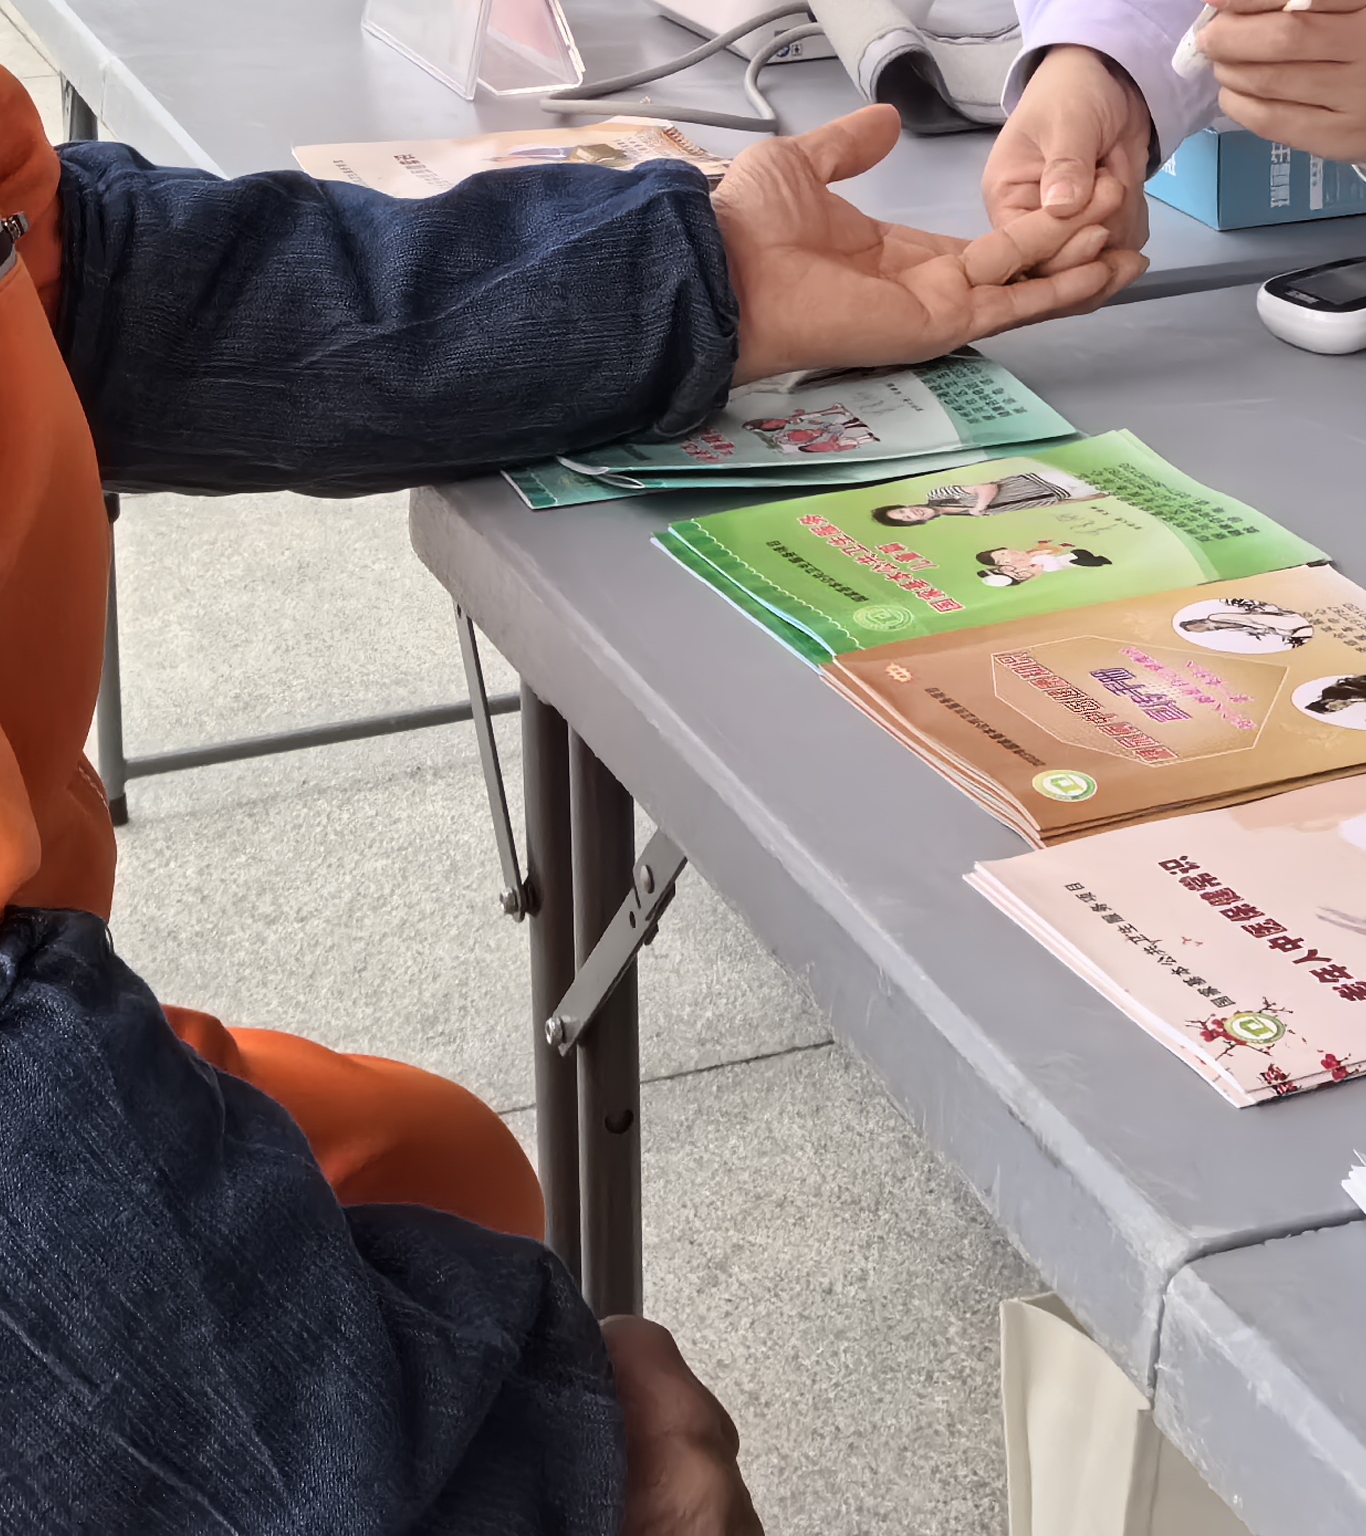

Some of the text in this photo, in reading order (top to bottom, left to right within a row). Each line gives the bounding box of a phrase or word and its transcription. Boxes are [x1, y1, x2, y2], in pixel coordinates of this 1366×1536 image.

[792, 512, 965, 613] 国家基本公共卫生服务
[1086, 665, 1193, 723] 宣传手册
[1062, 881, 1237, 1008] 国家基本公共卫生服务项目
